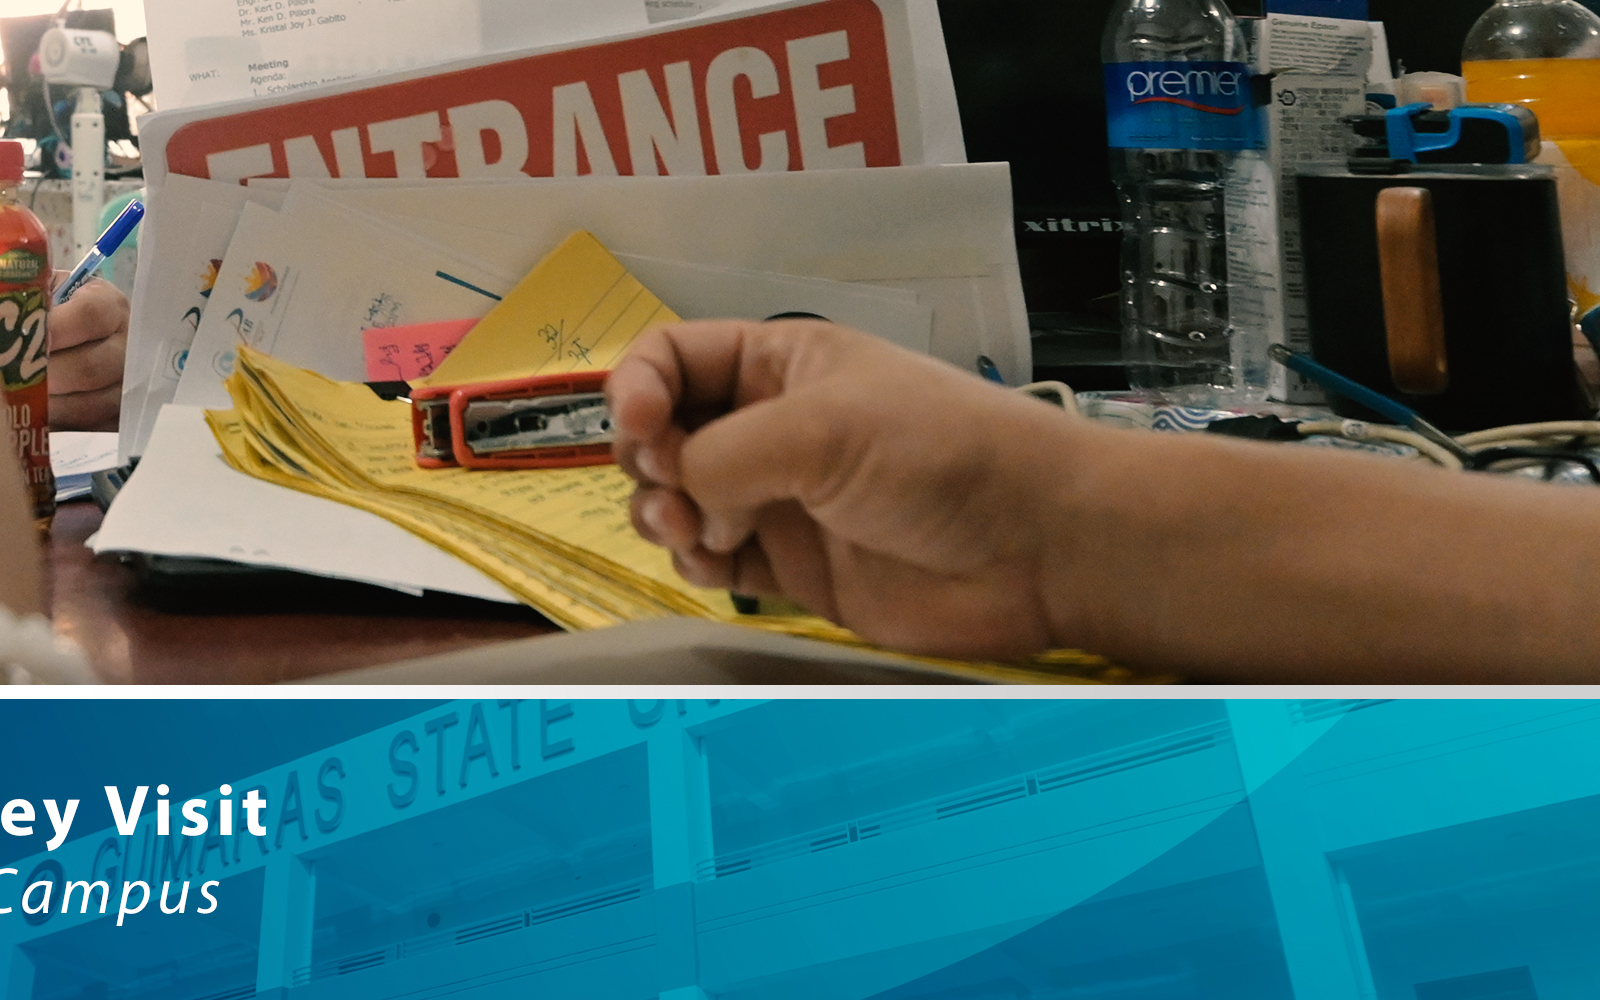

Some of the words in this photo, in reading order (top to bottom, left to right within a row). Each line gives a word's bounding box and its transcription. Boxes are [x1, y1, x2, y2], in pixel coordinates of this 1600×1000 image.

[238, 8, 252, 17] Dr.
[254, 4, 273, 13] Kert
[275, 1, 285, 9] D.
[240, 19, 255, 27] Mr.
[258, 15, 274, 24] Ken
[277, 12, 287, 20] D.
[242, 29, 257, 37] Ms.
[260, 23, 287, 34] Kristal
[290, 21, 304, 30] Joy
[248, 60, 289, 72] Meeting
[189, 70, 220, 82] WHAT:
[250, 73, 286, 85] Agenda:
[1127, 71, 1242, 101] premier
